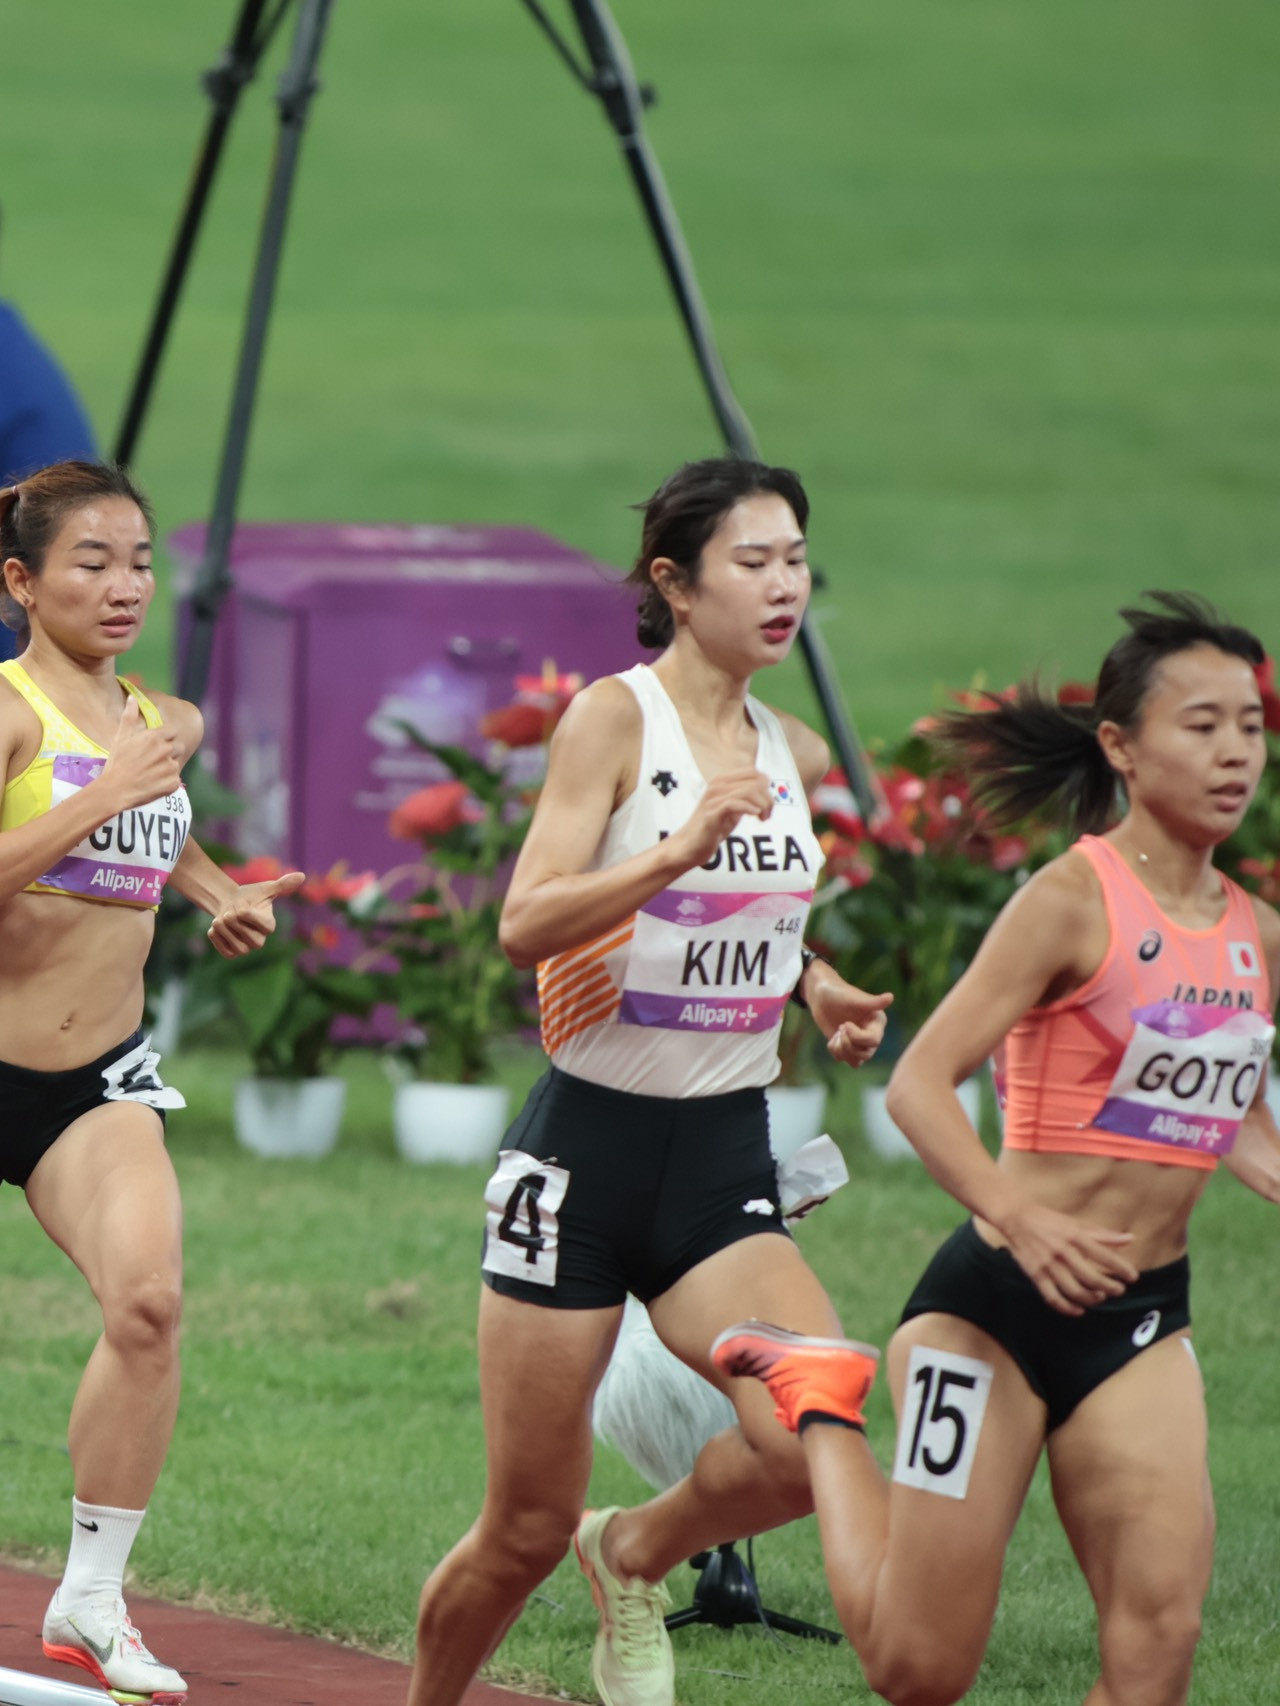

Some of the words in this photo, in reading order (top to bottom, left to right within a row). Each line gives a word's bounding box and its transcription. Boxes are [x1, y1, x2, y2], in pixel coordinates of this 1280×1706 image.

[165, 795, 185, 813] 938
[76, 809, 187, 862] GUYEN
[659, 831, 809, 872] REA
[775, 917, 801, 935] 448
[680, 940, 771, 986] KIM
[498, 1174, 547, 1265] 4
[908, 1364, 977, 1476] 15
